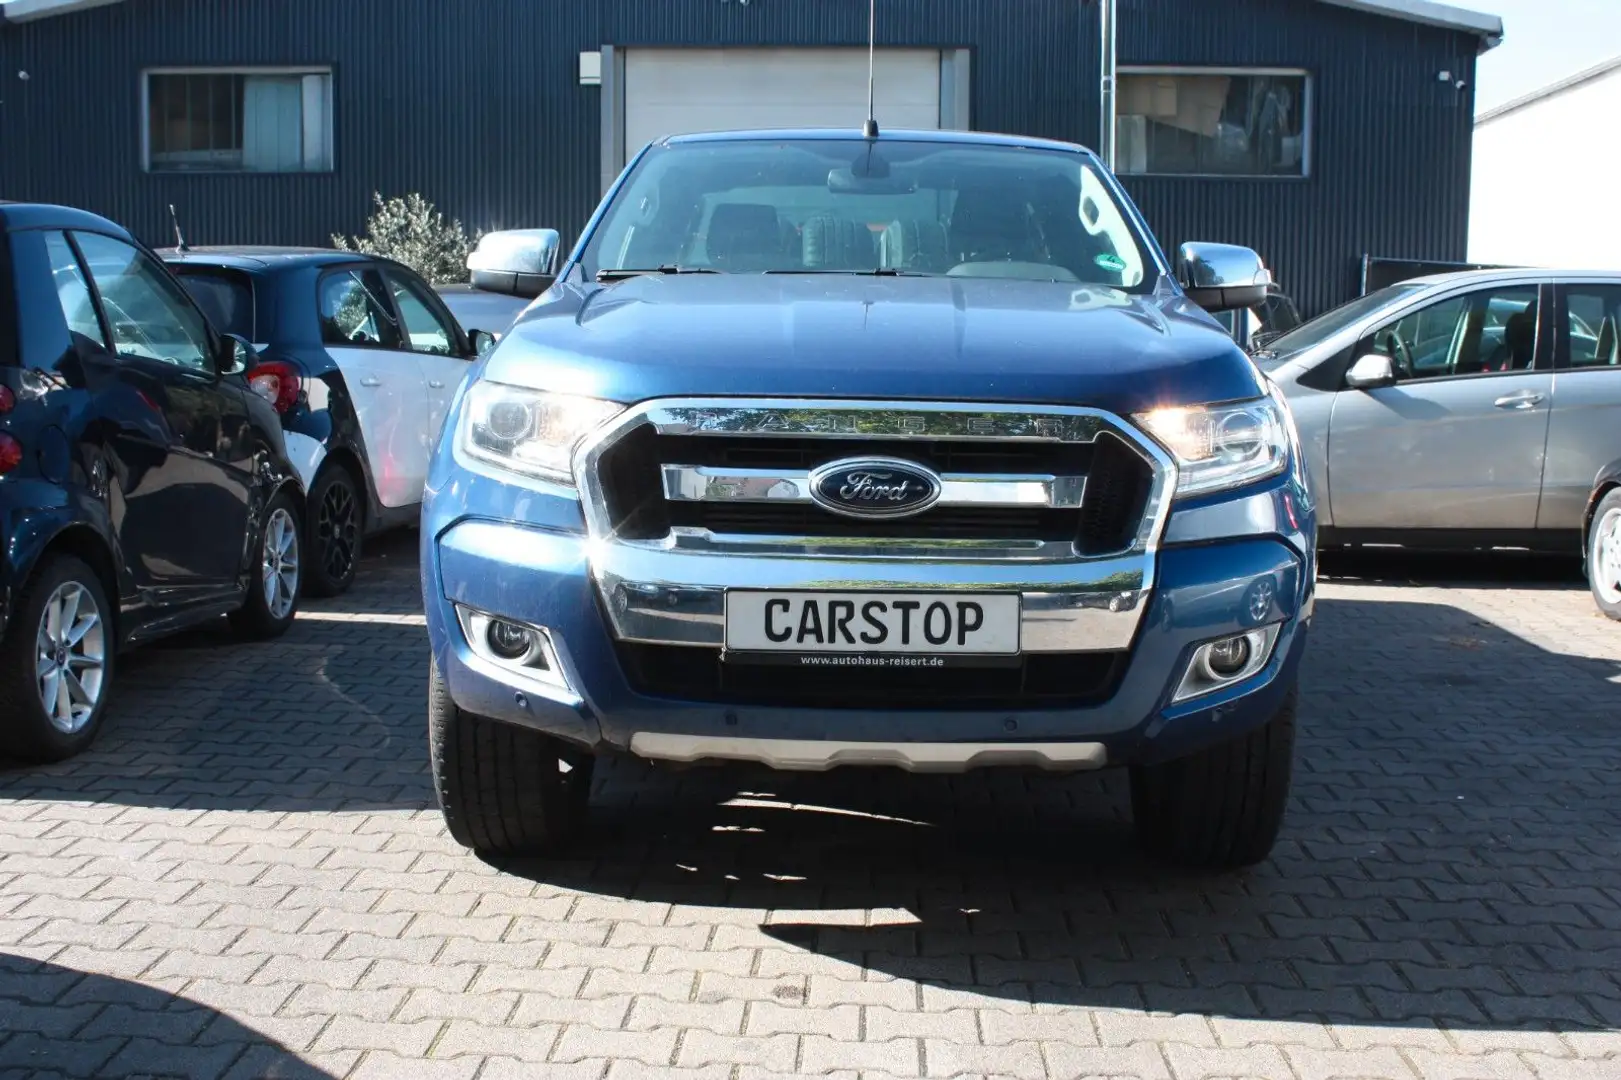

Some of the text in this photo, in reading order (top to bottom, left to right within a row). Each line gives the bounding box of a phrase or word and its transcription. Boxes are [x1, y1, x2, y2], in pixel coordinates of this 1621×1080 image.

[840, 471, 909, 500] Ford
[764, 598, 984, 646] CARSTOP
[800, 655, 945, 667] www.autohaus-reisert.de
